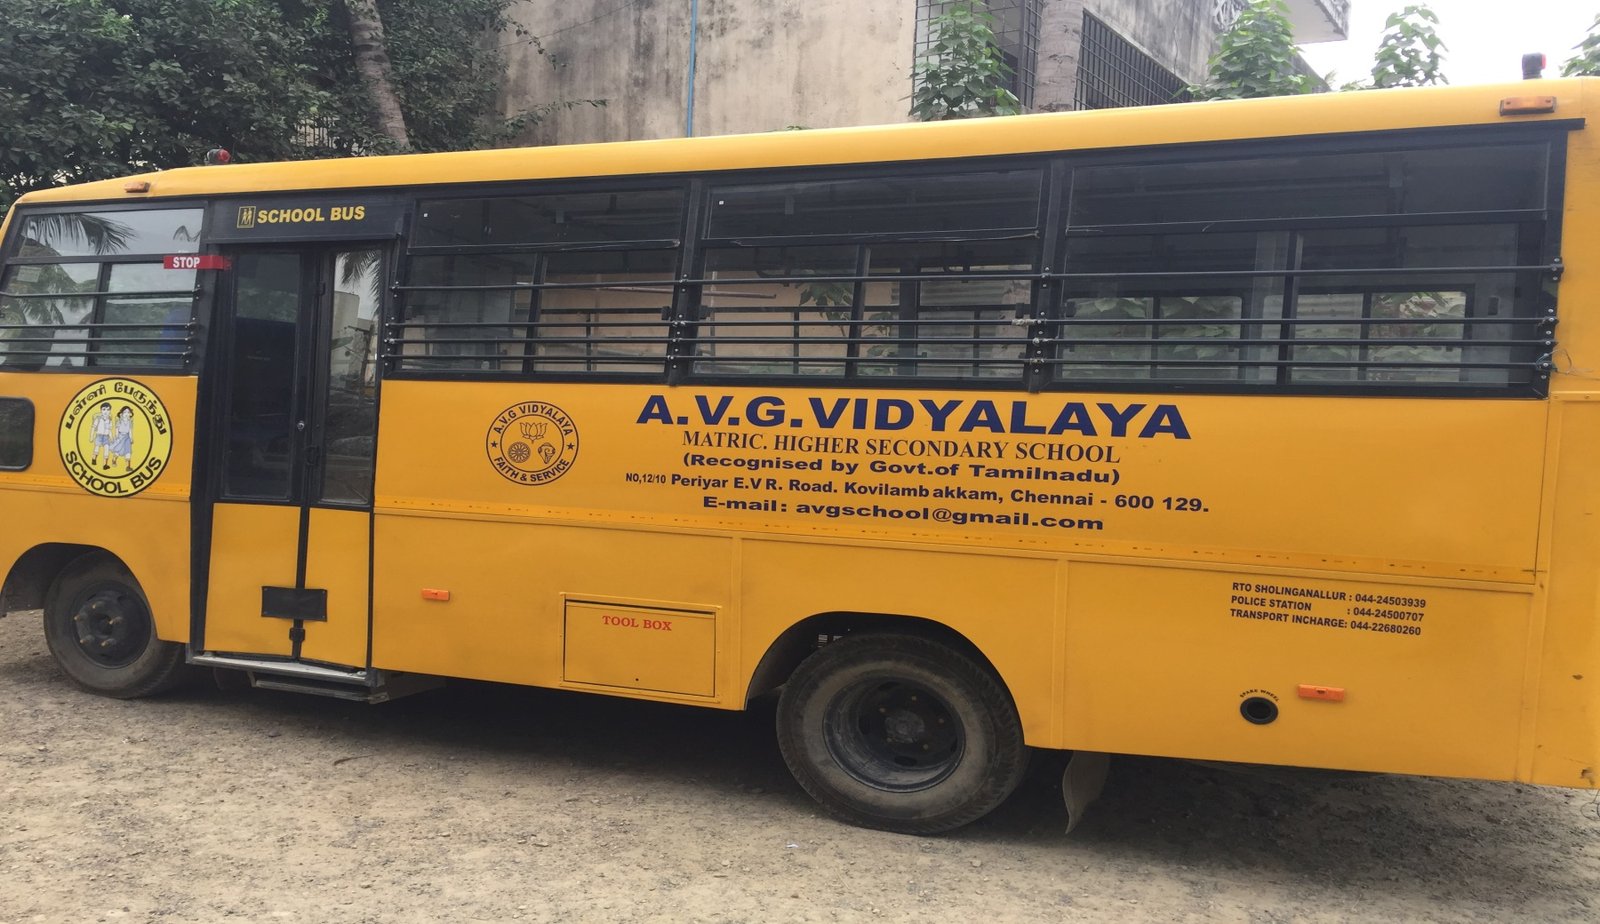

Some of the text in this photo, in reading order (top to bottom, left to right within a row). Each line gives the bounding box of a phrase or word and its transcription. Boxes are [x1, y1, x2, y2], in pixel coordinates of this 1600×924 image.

[257, 206, 365, 224] SCHOOL BUS
[172, 256, 200, 268] STOP
[65, 381, 167, 435] பள்ளி பேருந்து
[519, 404, 573, 436] VIDYALAYA
[636, 394, 1192, 440] A.V.G.VIDYALAYA
[682, 430, 1121, 464] MATRIC. HIGHER SECONDARY SCHOOL
[65, 450, 162, 493] SCHOOL BUS
[494, 457, 569, 482] FAITH & SERVICE
[683, 452, 1121, 486] (Recognised by Govt.of Tamilnadu)
[671, 473, 729, 491] Periyar
[788, 479, 838, 494] Road.
[1010, 488, 1094, 507] Chennai
[1114, 494, 1155, 510] 600
[1162, 496, 1210, 513] 129.
[795, 504, 1104, 531] avgschool@gmail.com
[1231, 595, 1267, 607] POLICE
[1269, 599, 1312, 611] STATION
[1353, 607, 1425, 623] 044-24500707
[1232, 582, 1252, 592] RTO
[1255, 584, 1346, 601] SHOLINGANALLUR
[1355, 593, 1427, 609] 044-24503939
[602, 616, 672, 631] TOOL BOX
[1230, 609, 1421, 636] TRANSPORT INCHARGE: 044-22680260
